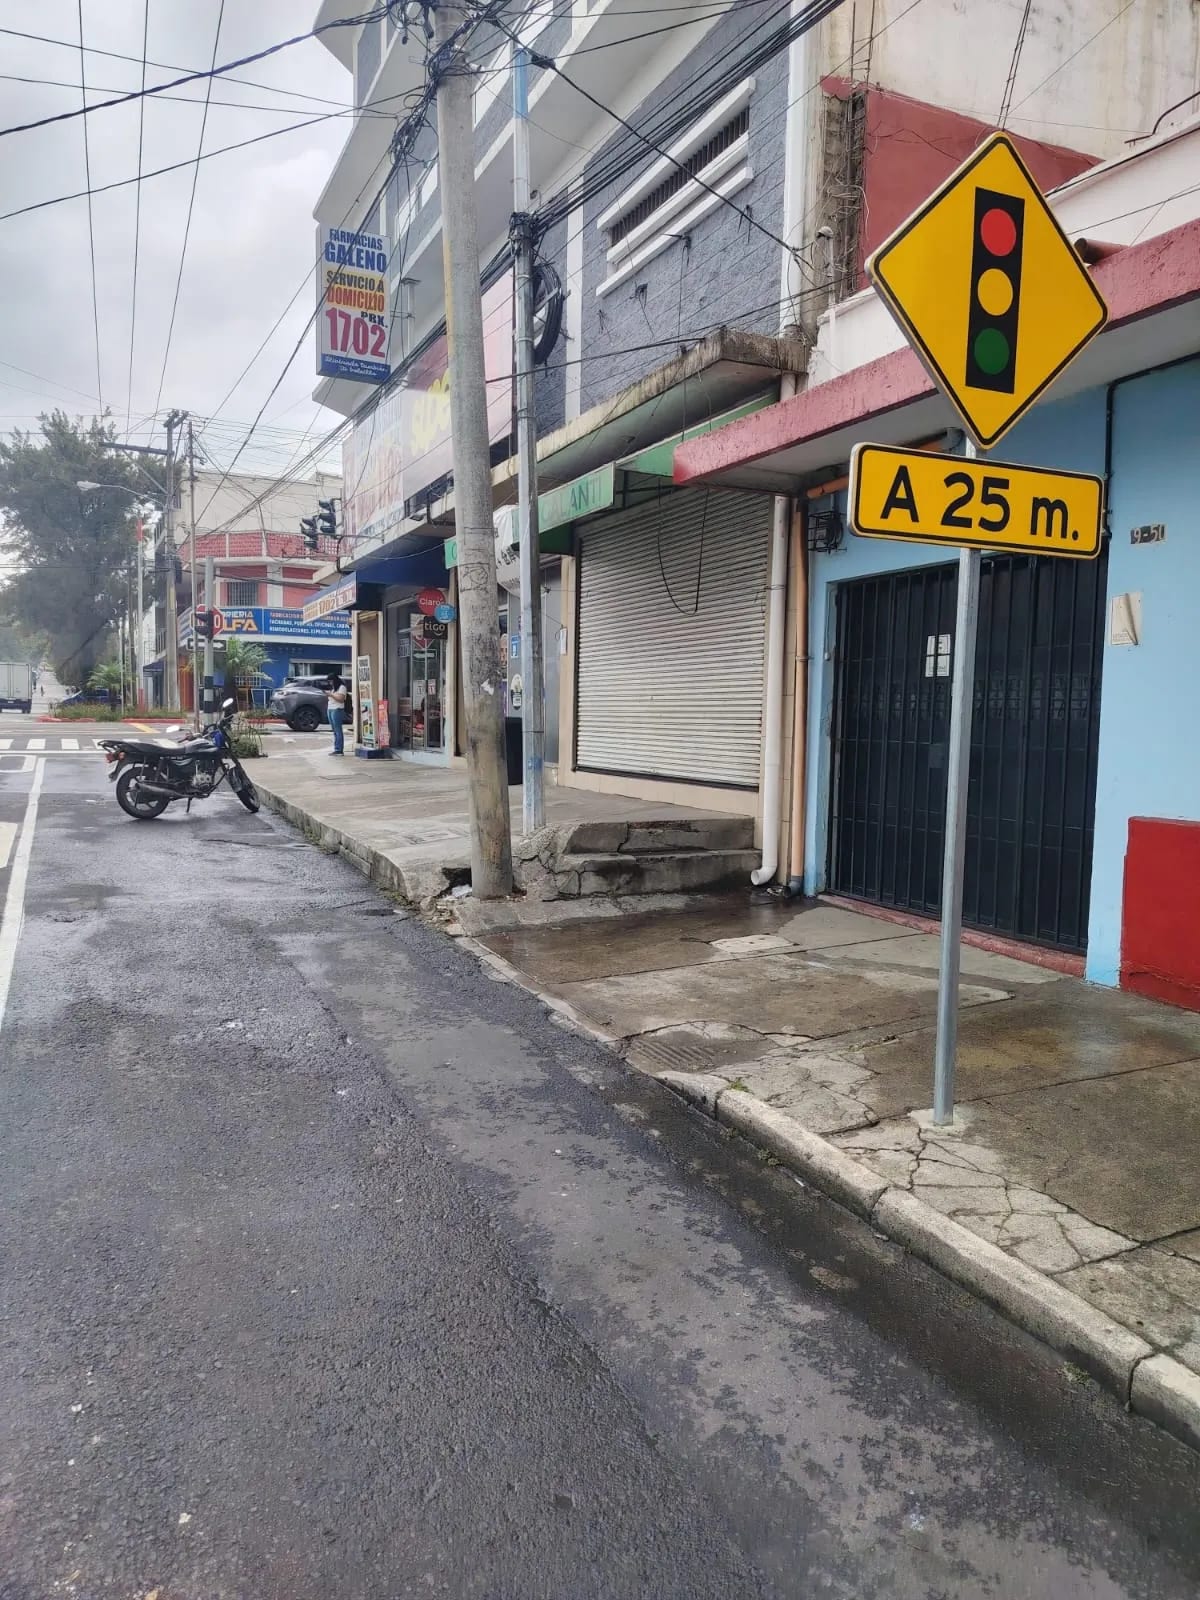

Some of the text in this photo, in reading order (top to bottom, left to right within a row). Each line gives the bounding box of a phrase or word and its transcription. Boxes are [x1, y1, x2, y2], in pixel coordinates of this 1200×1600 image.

[329, 228, 383, 251] FARMACIAS
[324, 241, 387, 273] GALENO
[326, 270, 385, 293] SERVICIO A
[327, 286, 385, 313] DOMICILIO
[325, 307, 386, 358] 1702
[880, 465, 1079, 541] A 25 m.
[222, 610, 254, 619] RIERIA
[420, 597, 441, 607] Claro
